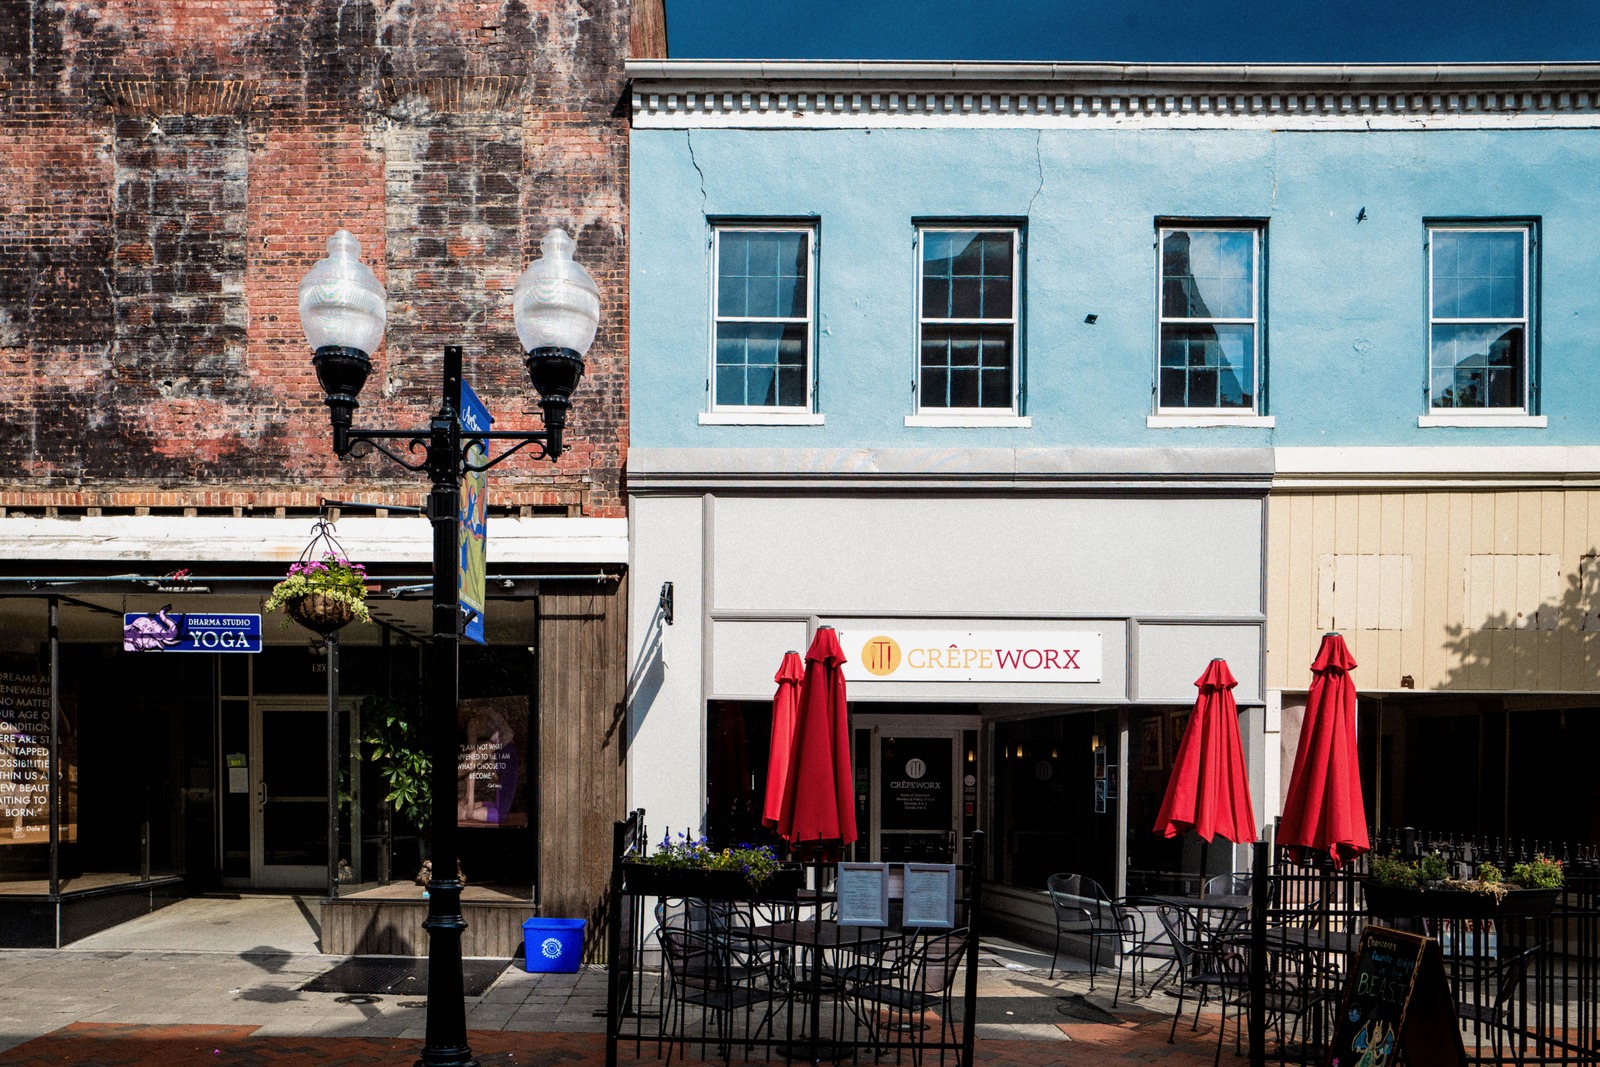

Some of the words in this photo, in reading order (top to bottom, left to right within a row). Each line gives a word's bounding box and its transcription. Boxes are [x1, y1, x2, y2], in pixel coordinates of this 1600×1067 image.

[188, 618, 221, 626] DHARMA
[222, 618, 251, 626] STUDIO
[189, 631, 250, 648] YOGA
[907, 644, 1081, 669] CRÊPEWORX
[17, 698, 50, 707] MATTE
[18, 711, 39, 719] AGE
[18, 735, 37, 743] ARE
[477, 743, 488, 751] NOT
[0, 759, 50, 768] OSSIBILITIE
[477, 762, 499, 770] CHOOSE
[499, 762, 506, 770] TO
[25, 771, 37, 780] US
[890, 780, 941, 789] CRÊPEWORX
[34, 796, 47, 805] TO
